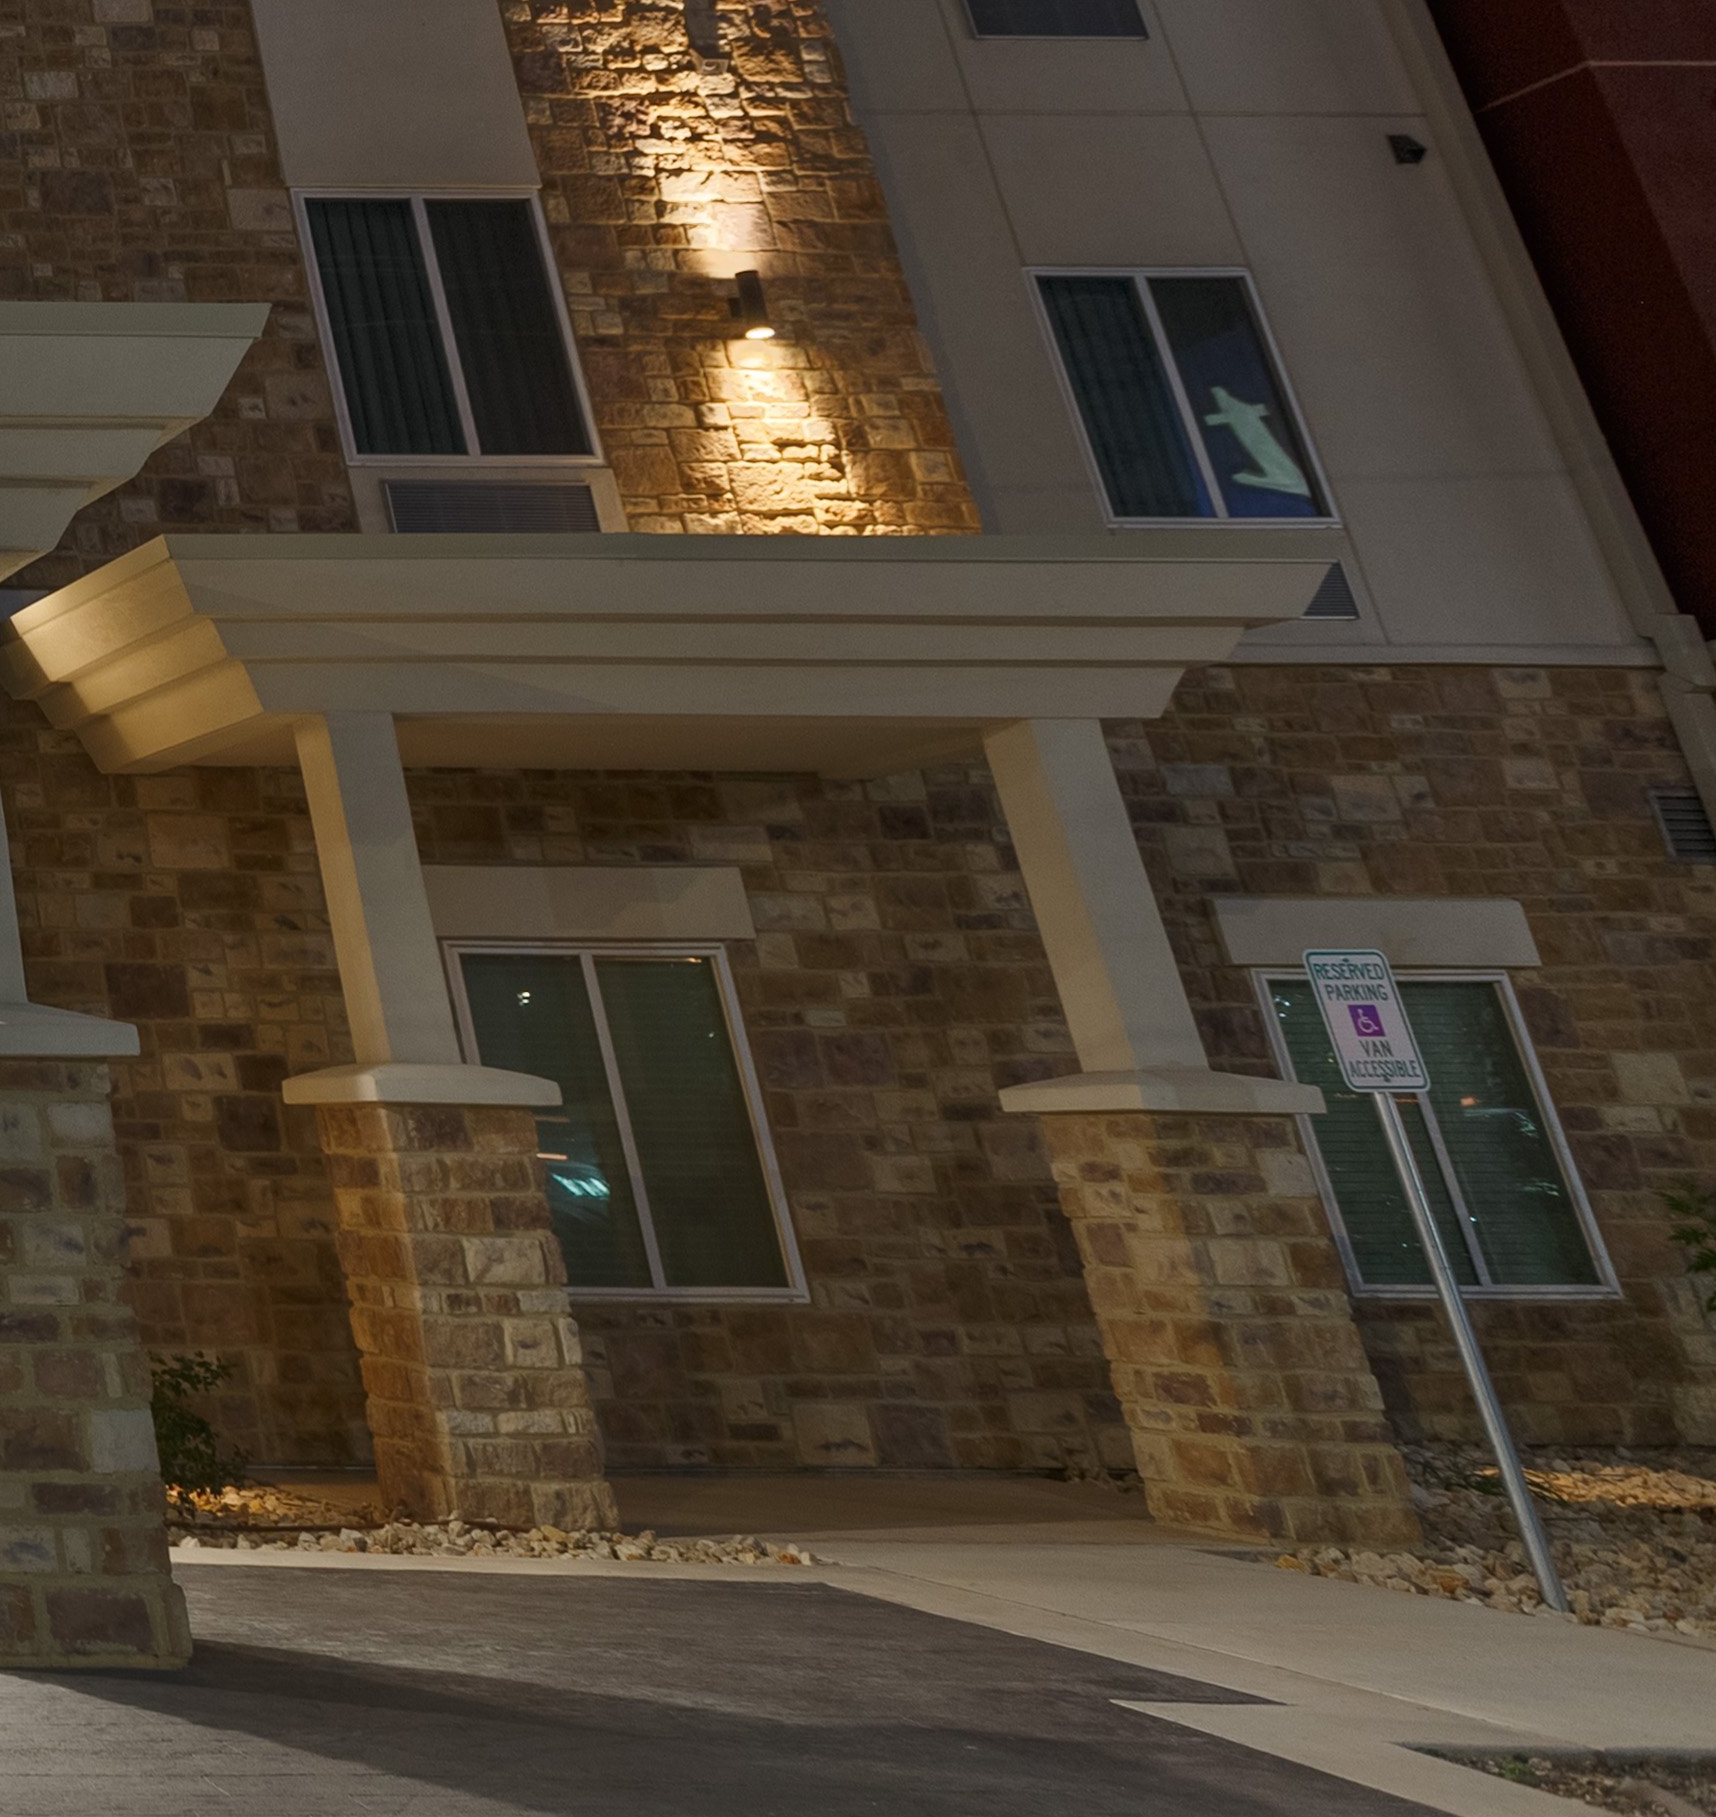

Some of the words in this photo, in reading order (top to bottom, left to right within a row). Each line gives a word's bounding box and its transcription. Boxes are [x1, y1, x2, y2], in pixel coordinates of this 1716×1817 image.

[1313, 963, 1385, 980] RESERVED
[1325, 984, 1388, 1001] PARKING
[1359, 1040, 1394, 1057] VAN
[1349, 1060, 1421, 1078] ACCESSIBLE
